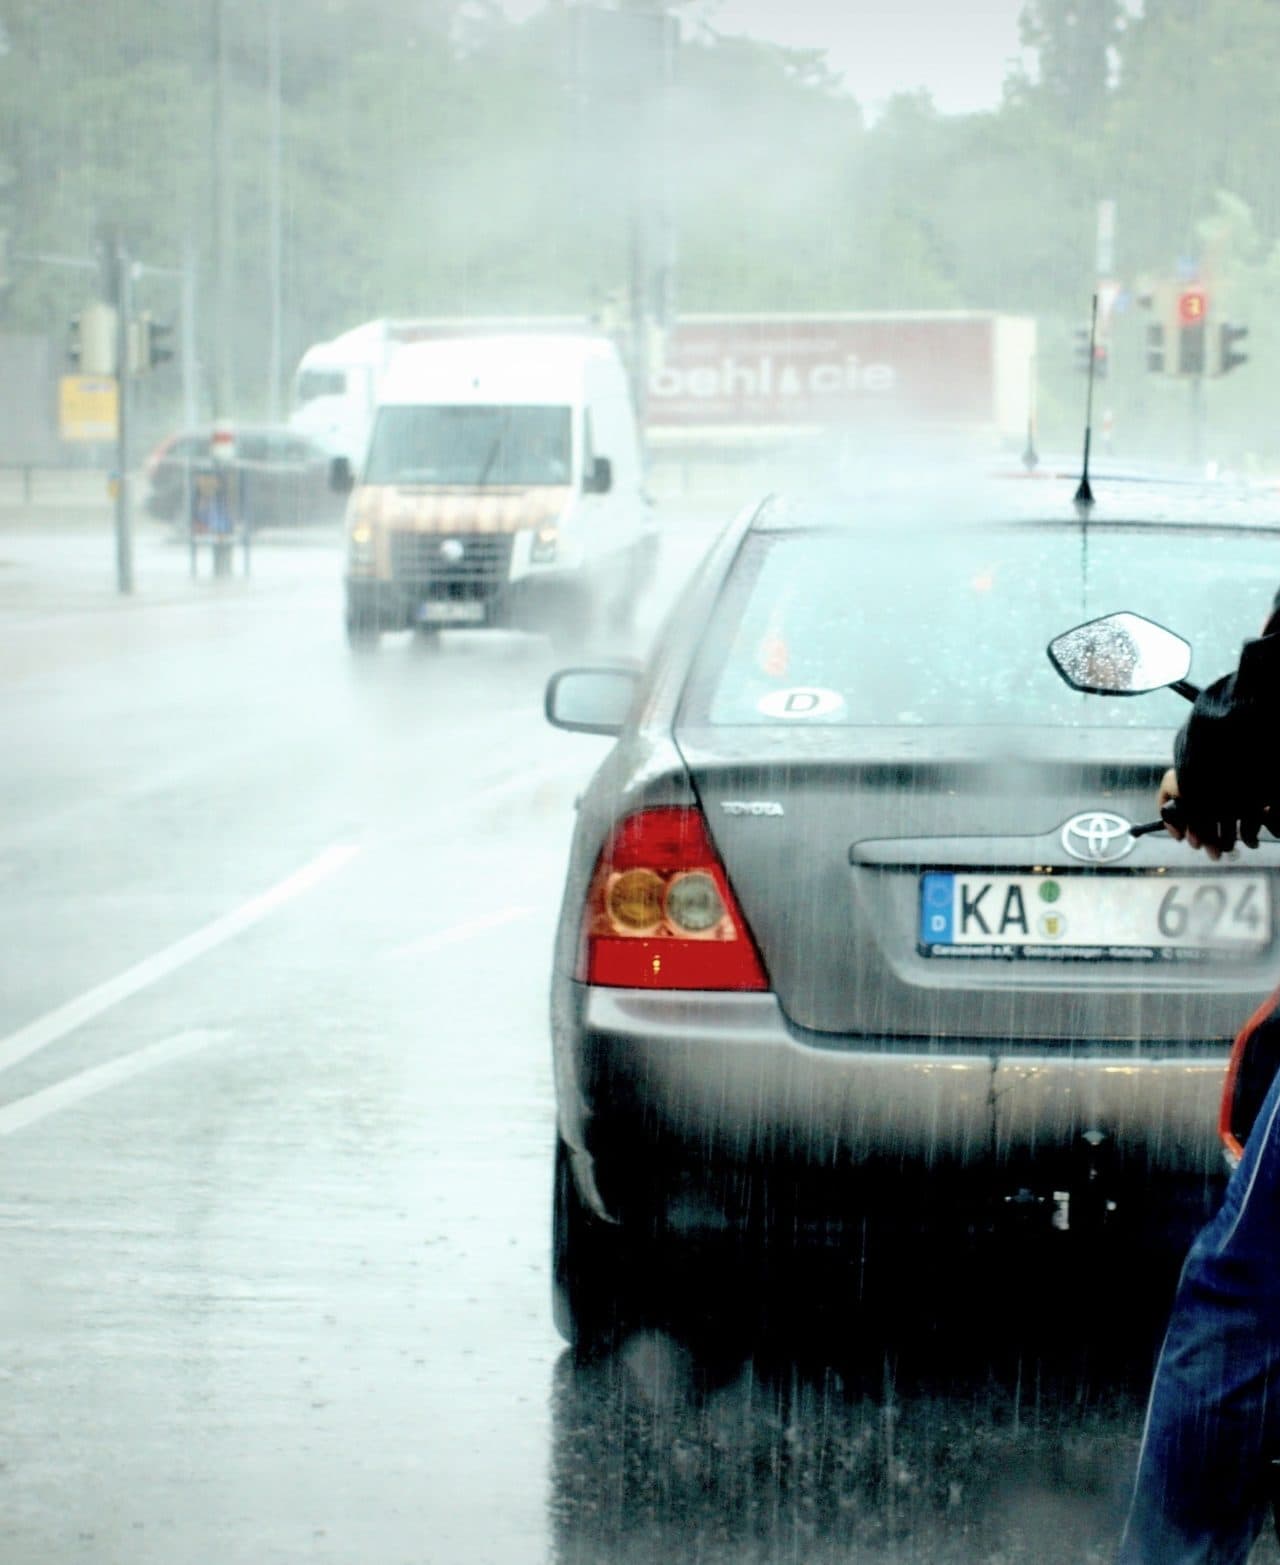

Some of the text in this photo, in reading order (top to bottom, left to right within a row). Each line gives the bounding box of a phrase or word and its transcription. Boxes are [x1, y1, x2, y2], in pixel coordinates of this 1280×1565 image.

[808, 353, 896, 393] cie
[783, 693, 820, 712] D
[720, 801, 785, 817] TOYOTA
[959, 883, 1030, 935] KA
